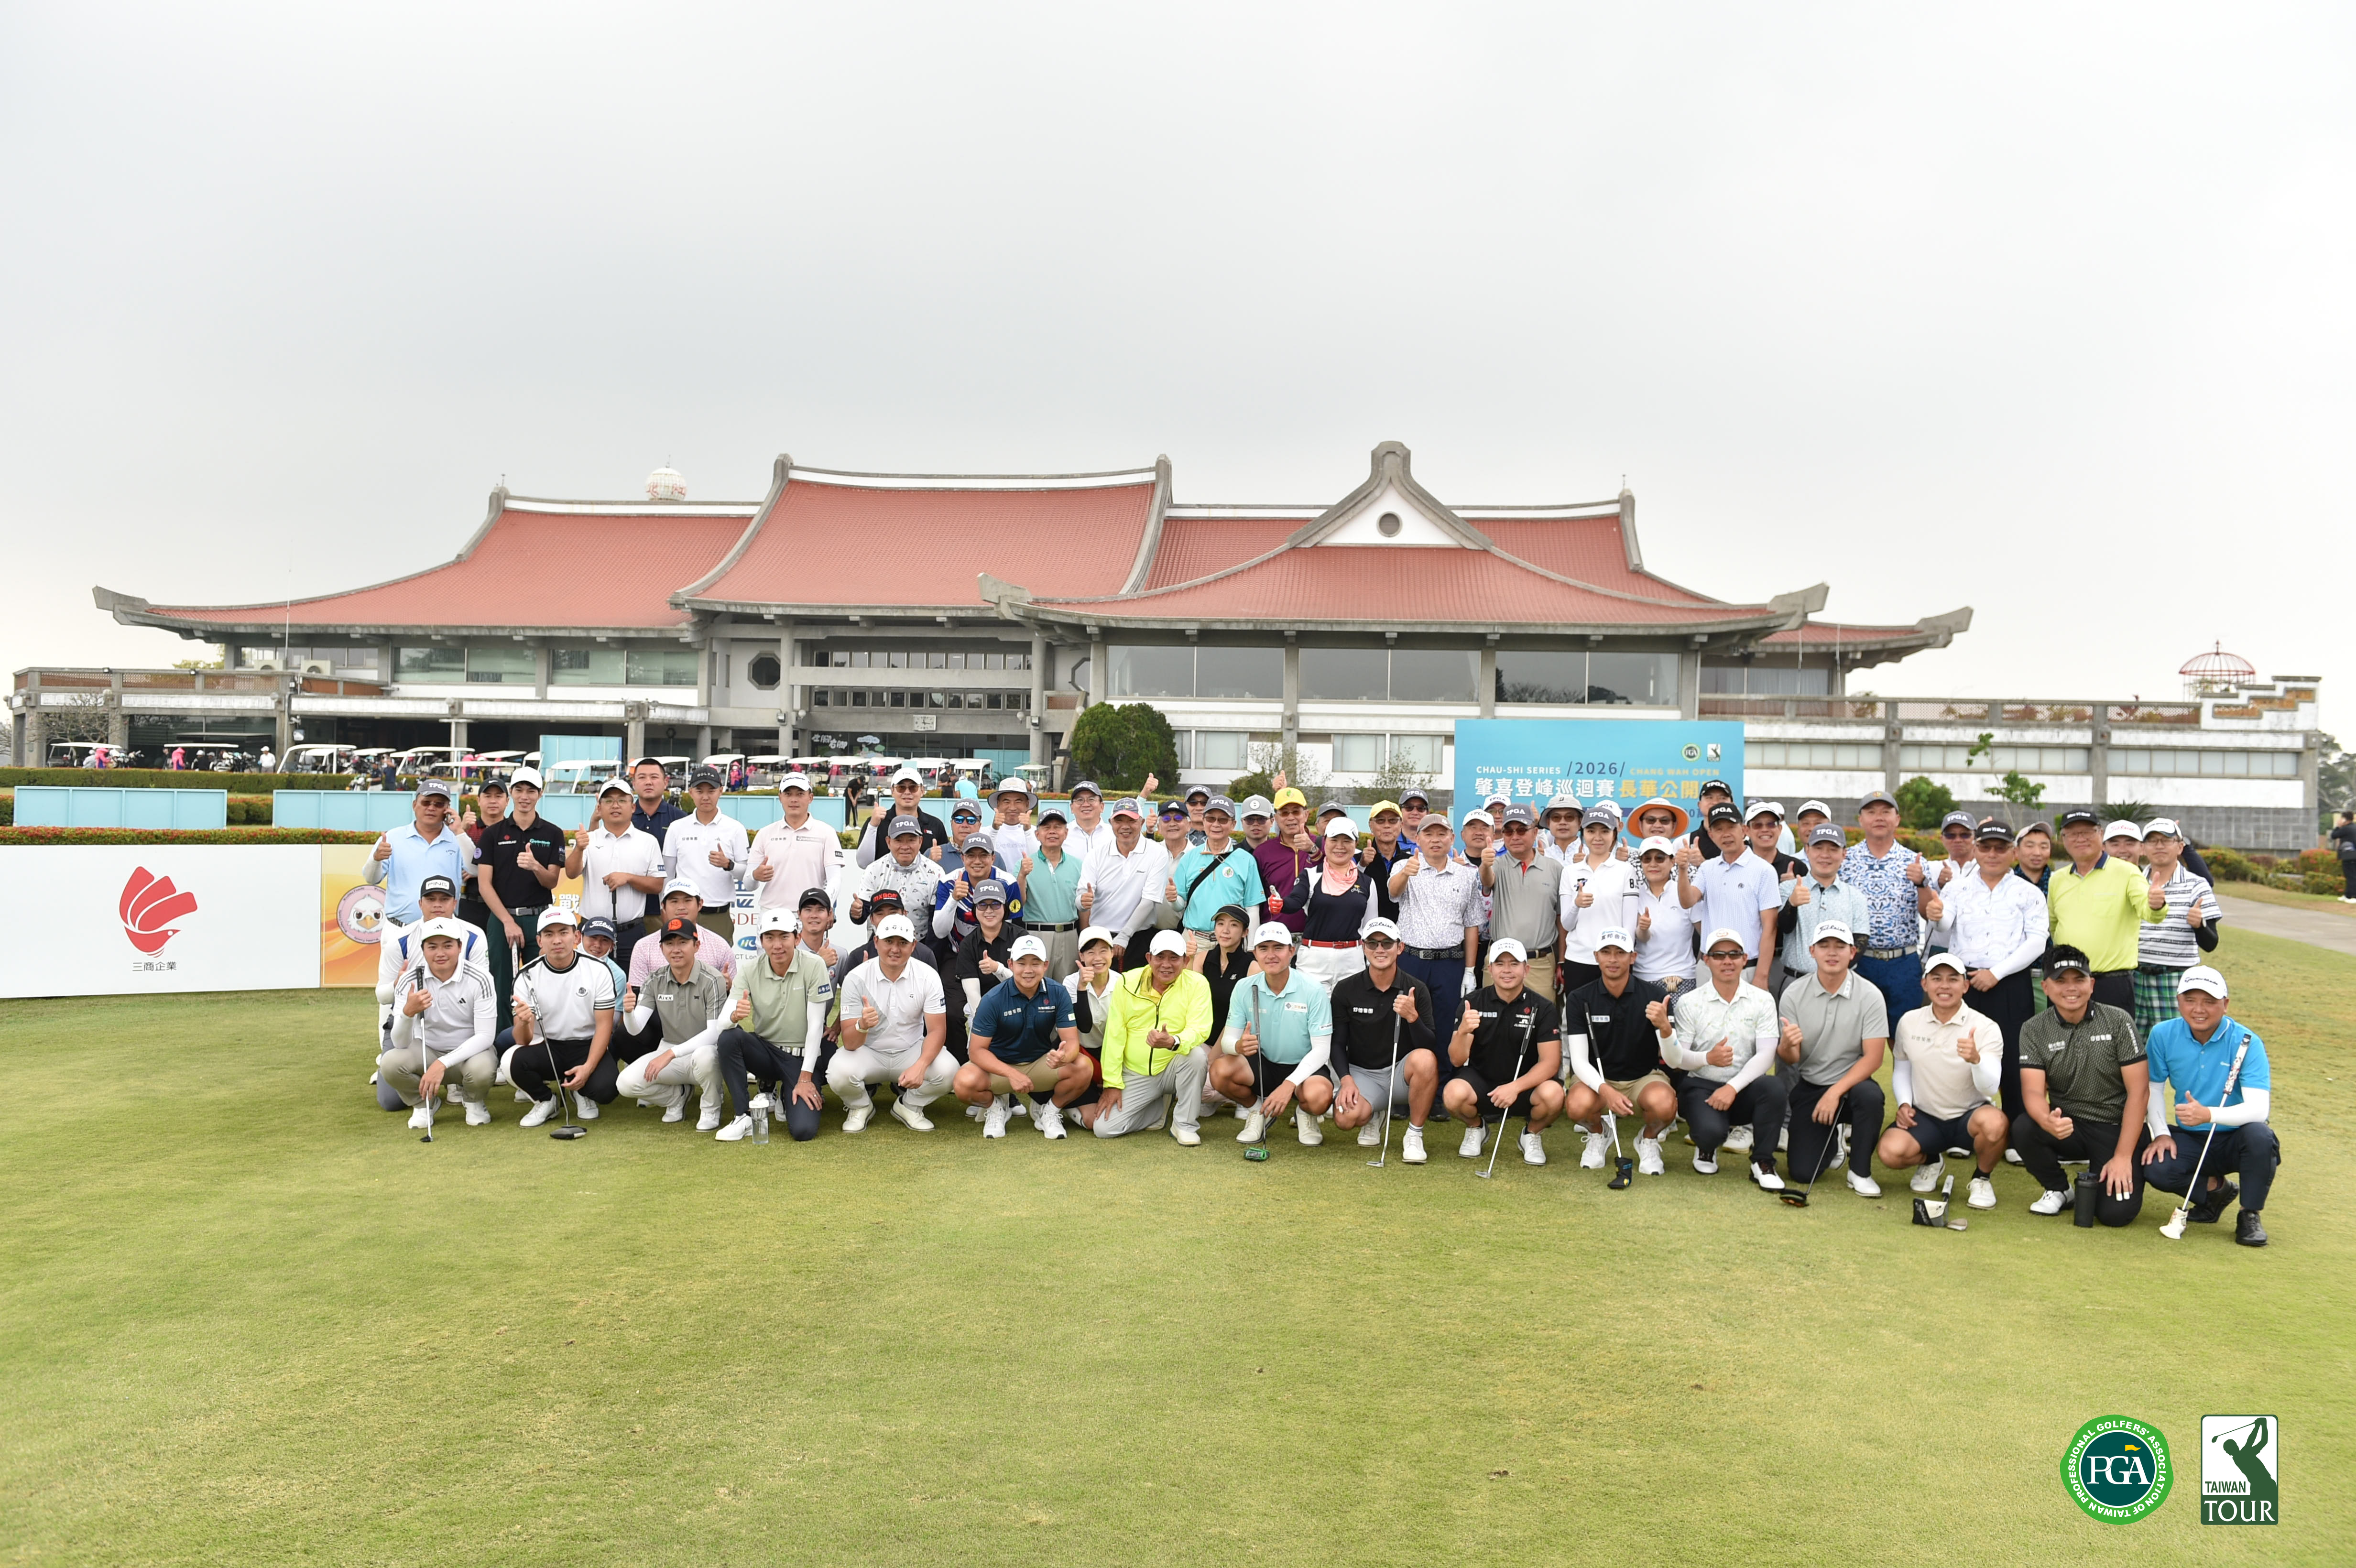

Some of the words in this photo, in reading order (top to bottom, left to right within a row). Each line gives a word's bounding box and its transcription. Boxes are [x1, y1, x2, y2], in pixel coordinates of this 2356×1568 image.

[429, 783, 447, 791] TPGA
[1619, 780, 1706, 799] 長華公開
[1712, 807, 1733, 816] TPGA
[1816, 828, 1838, 837] TPGA
[132, 961, 176, 972] 三商企業
